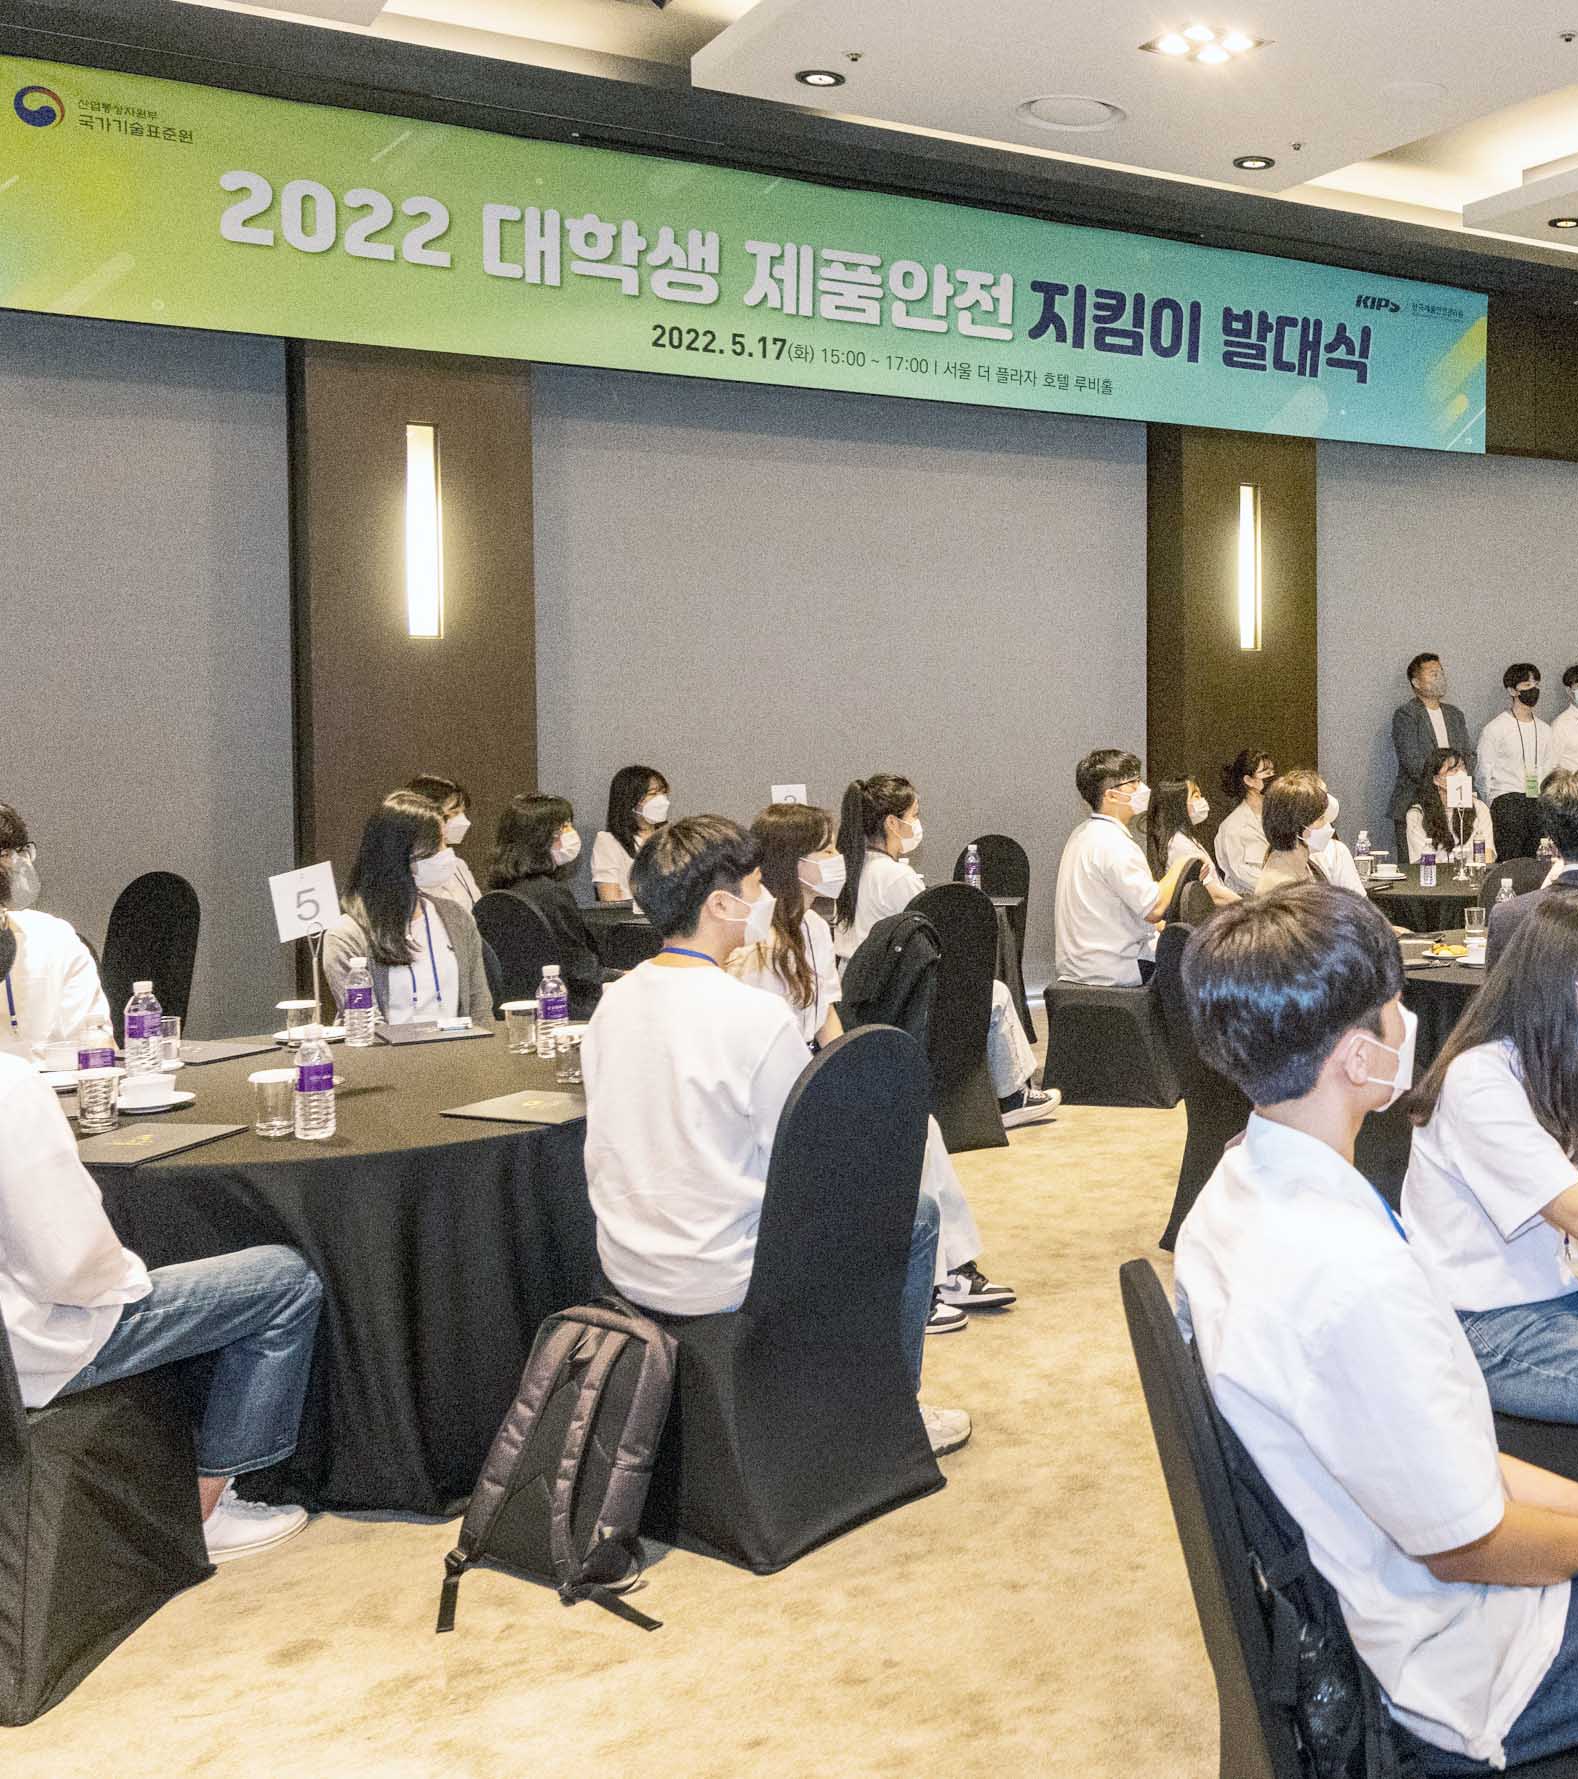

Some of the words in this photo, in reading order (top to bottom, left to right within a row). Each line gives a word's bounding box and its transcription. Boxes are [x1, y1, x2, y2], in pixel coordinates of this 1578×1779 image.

[78, 113, 194, 145] 국가기술표준원
[219, 170, 452, 268] 2022
[480, 202, 721, 307] 대학생
[743, 238, 1015, 343] 제품안전
[1027, 276, 1203, 365] 지킴이
[1220, 303, 1373, 386] 발대식
[821, 347, 866, 368] 15:00
[886, 355, 929, 375] 17:00
[943, 361, 972, 381] 서울
[977, 364, 991, 383] 더
[1042, 371, 1069, 392] 호텔
[1073, 375, 1113, 397] 루비홀
[1455, 784, 1463, 801] 1
[296, 887, 320, 921] 5
